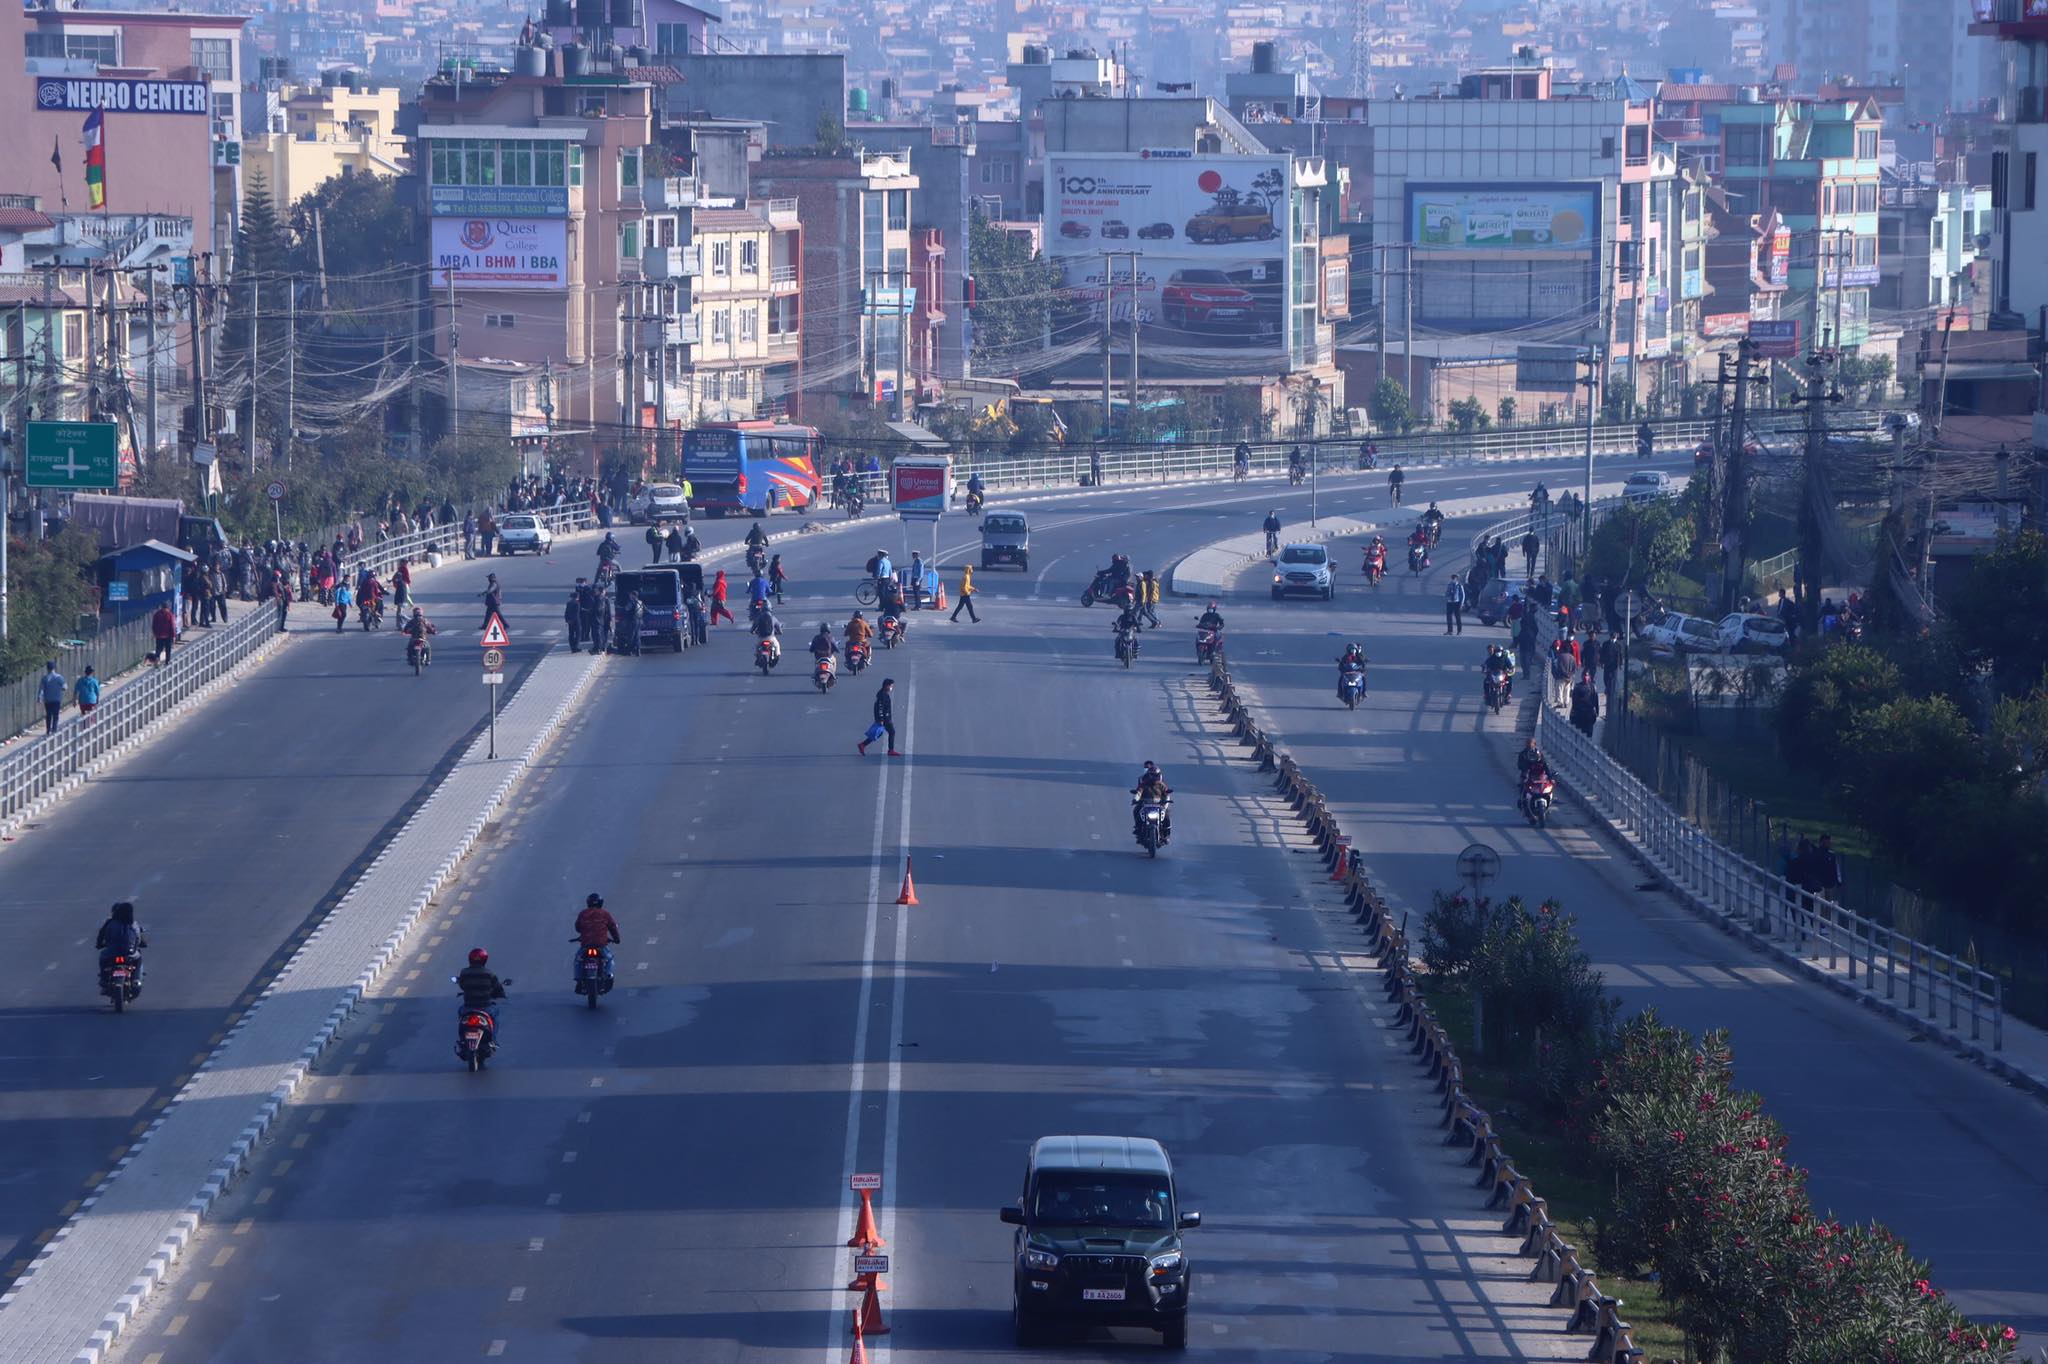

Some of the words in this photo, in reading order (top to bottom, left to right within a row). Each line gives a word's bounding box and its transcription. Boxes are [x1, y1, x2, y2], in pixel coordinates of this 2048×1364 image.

[67, 81, 130, 110] NEURO
[135, 83, 206, 111] CENTER
[1152, 150, 1191, 158] SUZUKI
[466, 189, 497, 202] Academia
[498, 189, 539, 202] International
[540, 189, 564, 206] College
[496, 220, 537, 235] Quest
[505, 241, 539, 250] College
[440, 255, 470, 267] MBA
[485, 256, 516, 268] BHM
[530, 256, 558, 268] BBA
[914, 477, 939, 487] United
[488, 652, 499, 663] 50
